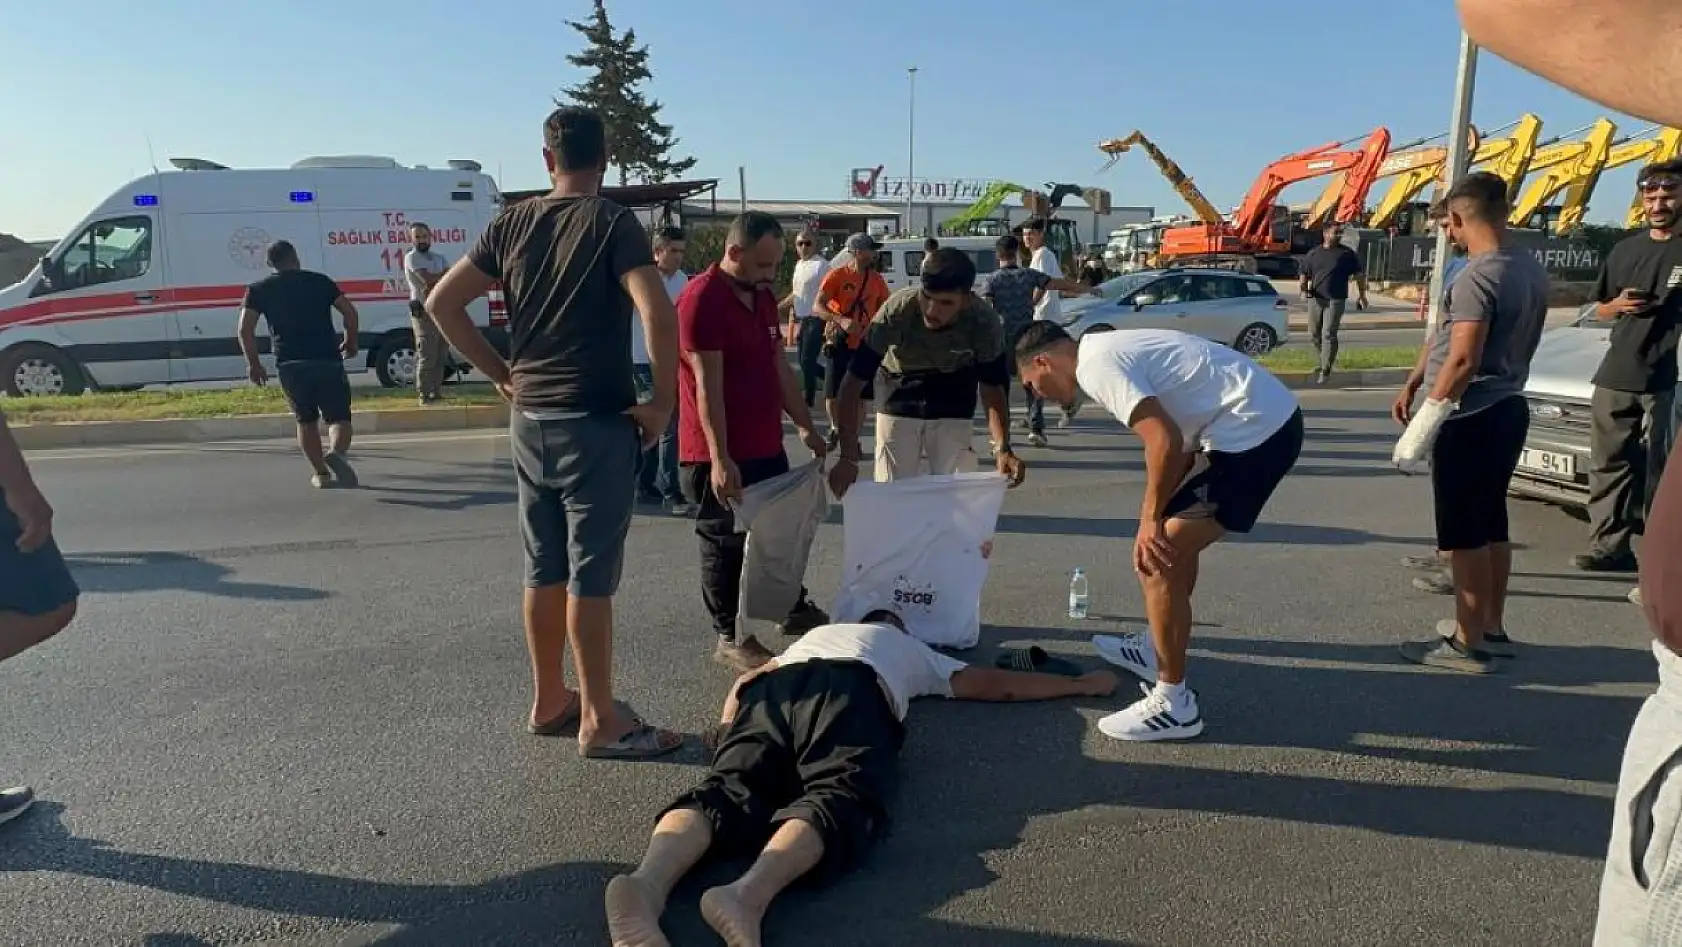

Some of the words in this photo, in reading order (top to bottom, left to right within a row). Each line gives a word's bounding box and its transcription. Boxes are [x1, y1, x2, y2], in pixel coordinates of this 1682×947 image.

[328, 230, 382, 246] SAĞLIK
[388, 226, 467, 244] BANLIĞI
[894, 588, 933, 605] BOSS
